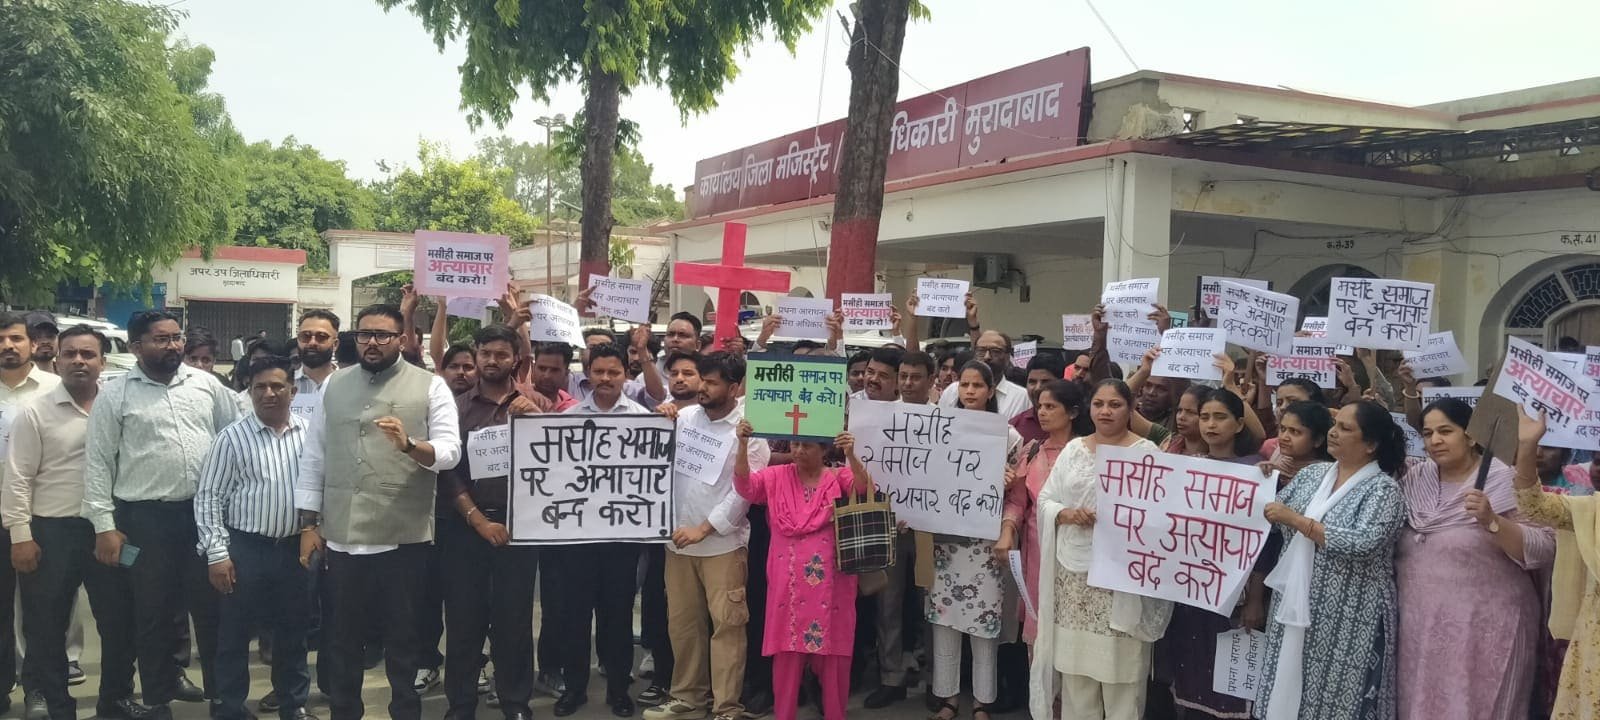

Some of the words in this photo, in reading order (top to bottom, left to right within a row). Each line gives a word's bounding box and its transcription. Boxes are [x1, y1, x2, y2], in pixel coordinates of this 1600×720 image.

[700, 163, 742, 197] कार्यालय
[744, 153, 774, 188] जिला
[776, 138, 831, 184] मजिस्ट्रेट
[889, 97, 959, 155] धिकारी
[965, 82, 1063, 155] मुरादाबाद
[428, 246, 453, 260] मसीही
[455, 251, 481, 261] समाज
[483, 252, 494, 262] पर
[190, 267, 212, 276] अपर
[214, 268, 227, 278] उप
[229, 267, 280, 280] जिलाधिकारी
[428, 260, 494, 275] अत्याचार
[436, 272, 454, 283] बंद
[458, 273, 487, 285] करो!
[595, 279, 616, 289] मसीह
[1128, 282, 1150, 290] समाज
[1203, 281, 1221, 293] मसी
[843, 297, 863, 308] मसीही
[864, 300, 884, 308] समाज
[1116, 296, 1147, 304] अत्याचार
[1254, 295, 1288, 315] समाज
[1381, 286, 1431, 307] समाज
[843, 308, 891, 318] अत्याचार
[1225, 300, 1238, 314] पर
[1336, 298, 1359, 315] पर
[1368, 302, 1429, 324] अत्याचार
[1345, 317, 1374, 337] बन्द
[1188, 332, 1214, 341] समाज
[1161, 347, 1173, 356] पर
[1175, 347, 1211, 357] अत्याचार
[1296, 346, 1321, 355] समाज
[1324, 347, 1335, 356] पर
[1183, 362, 1200, 373] करो
[1268, 355, 1335, 371] अत्याचार
[754, 363, 795, 383] मसीही
[799, 370, 828, 384] समाज
[829, 371, 843, 385] पर
[1510, 345, 1544, 371] मसीही
[1545, 363, 1576, 393] समाज
[1576, 386, 1590, 403] पर
[753, 388, 793, 403] अत्याचार
[798, 387, 813, 404] बंद
[1505, 358, 1585, 420] अत्याचार
[1512, 381, 1529, 404] बंद
[883, 407, 955, 445] मसीह
[530, 419, 617, 464] मसीह
[617, 427, 676, 462] समाज
[861, 446, 932, 476] समाज
[947, 450, 983, 480] पर
[520, 467, 554, 497] पर
[565, 465, 670, 494] अत्याचार
[1099, 454, 1174, 502] मसीह
[1184, 470, 1259, 517] समाज
[542, 498, 588, 529] बन्द
[1114, 504, 1146, 546] पर
[1160, 513, 1263, 571] अत्याचार
[1127, 550, 1166, 590] बंद
[1174, 559, 1227, 606] करो
[1245, 633, 1258, 671] अधिकार
[1243, 674, 1255, 689] मेरा
